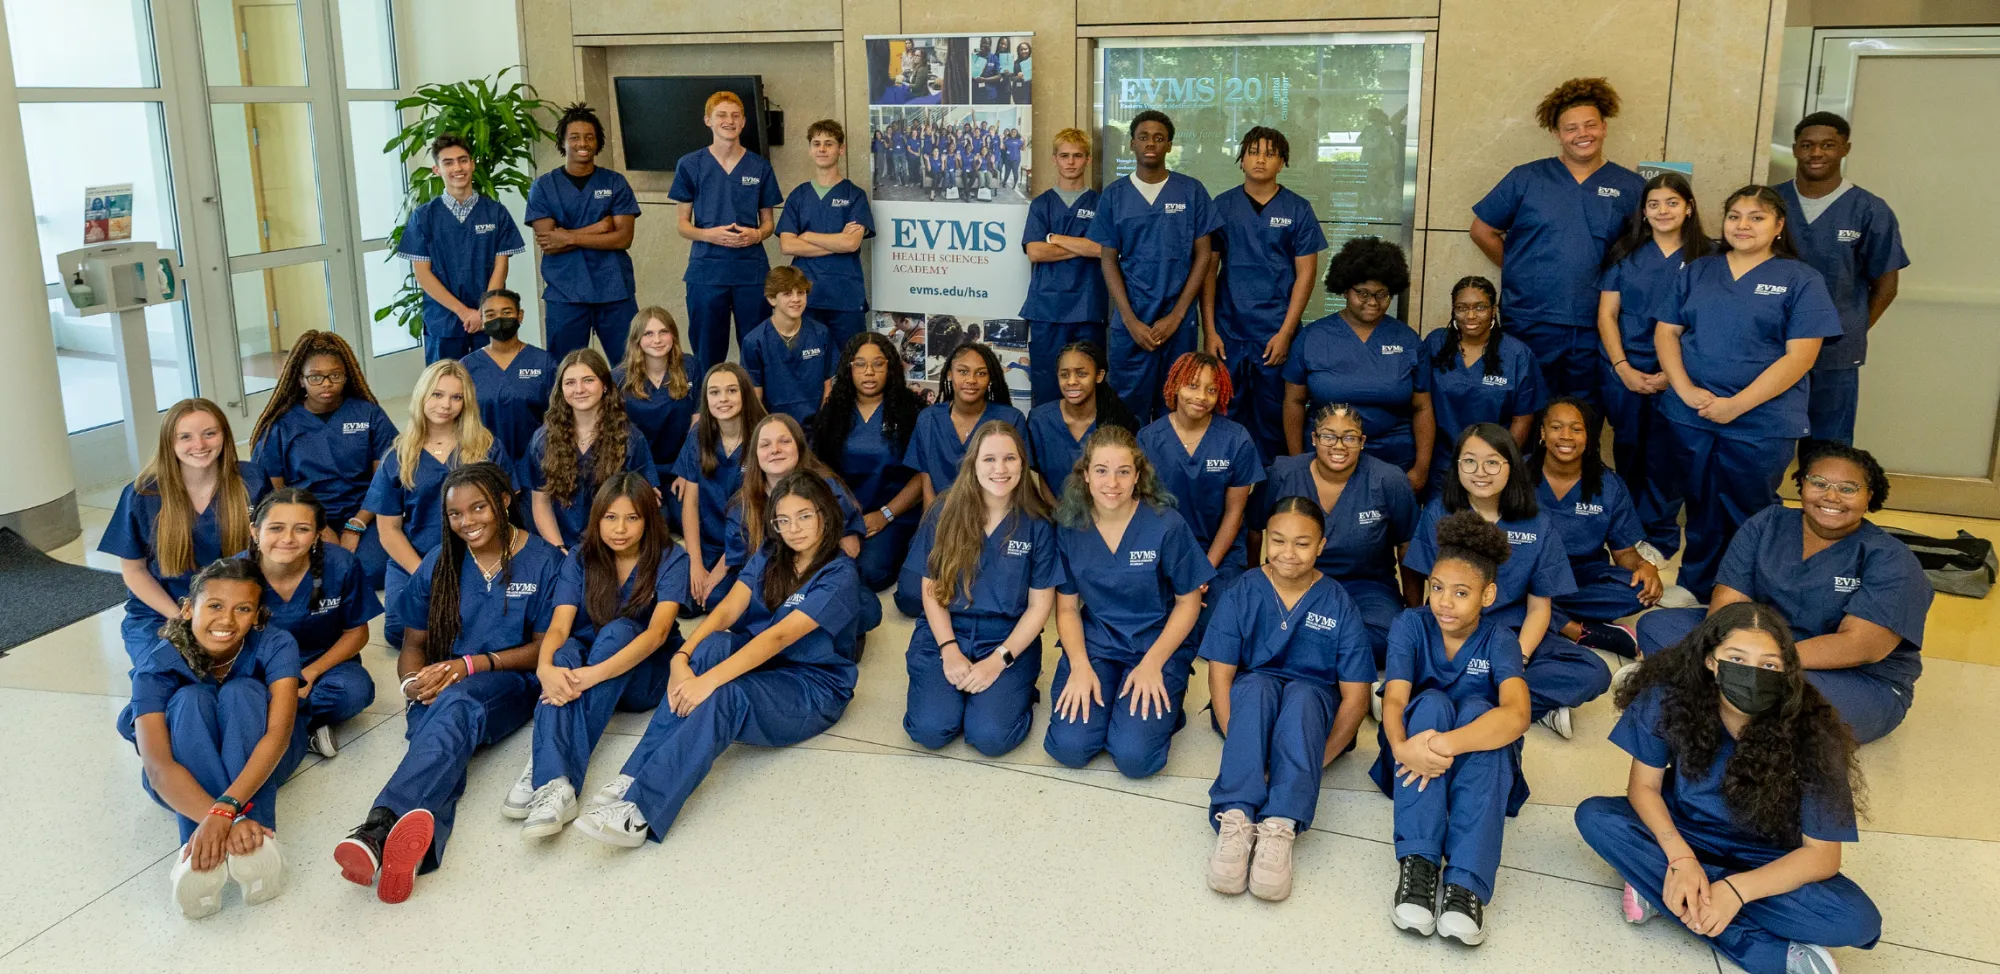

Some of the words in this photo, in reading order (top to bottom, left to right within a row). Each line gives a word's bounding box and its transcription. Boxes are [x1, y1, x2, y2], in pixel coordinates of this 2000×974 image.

[1119, 77, 1216, 103] EVMS
[1224, 77, 1262, 103] 20
[891, 218, 1007, 253] EVMS
[892, 252, 936, 262] HEALTH
[939, 254, 990, 265] SCIENCES
[892, 264, 949, 275] ACADEMY
[909, 286, 989, 298] evms.edu/hsa
[1755, 283, 1787, 293] EVMS
[1206, 459, 1230, 467] EVMS
[1575, 502, 1603, 512] EVMS
[1507, 530, 1537, 541] EVMS
[1129, 550, 1157, 559] EVMS
[507, 582, 537, 593] EVMS
[319, 596, 341, 607] VMS
[1306, 611, 1337, 628] EVMS
